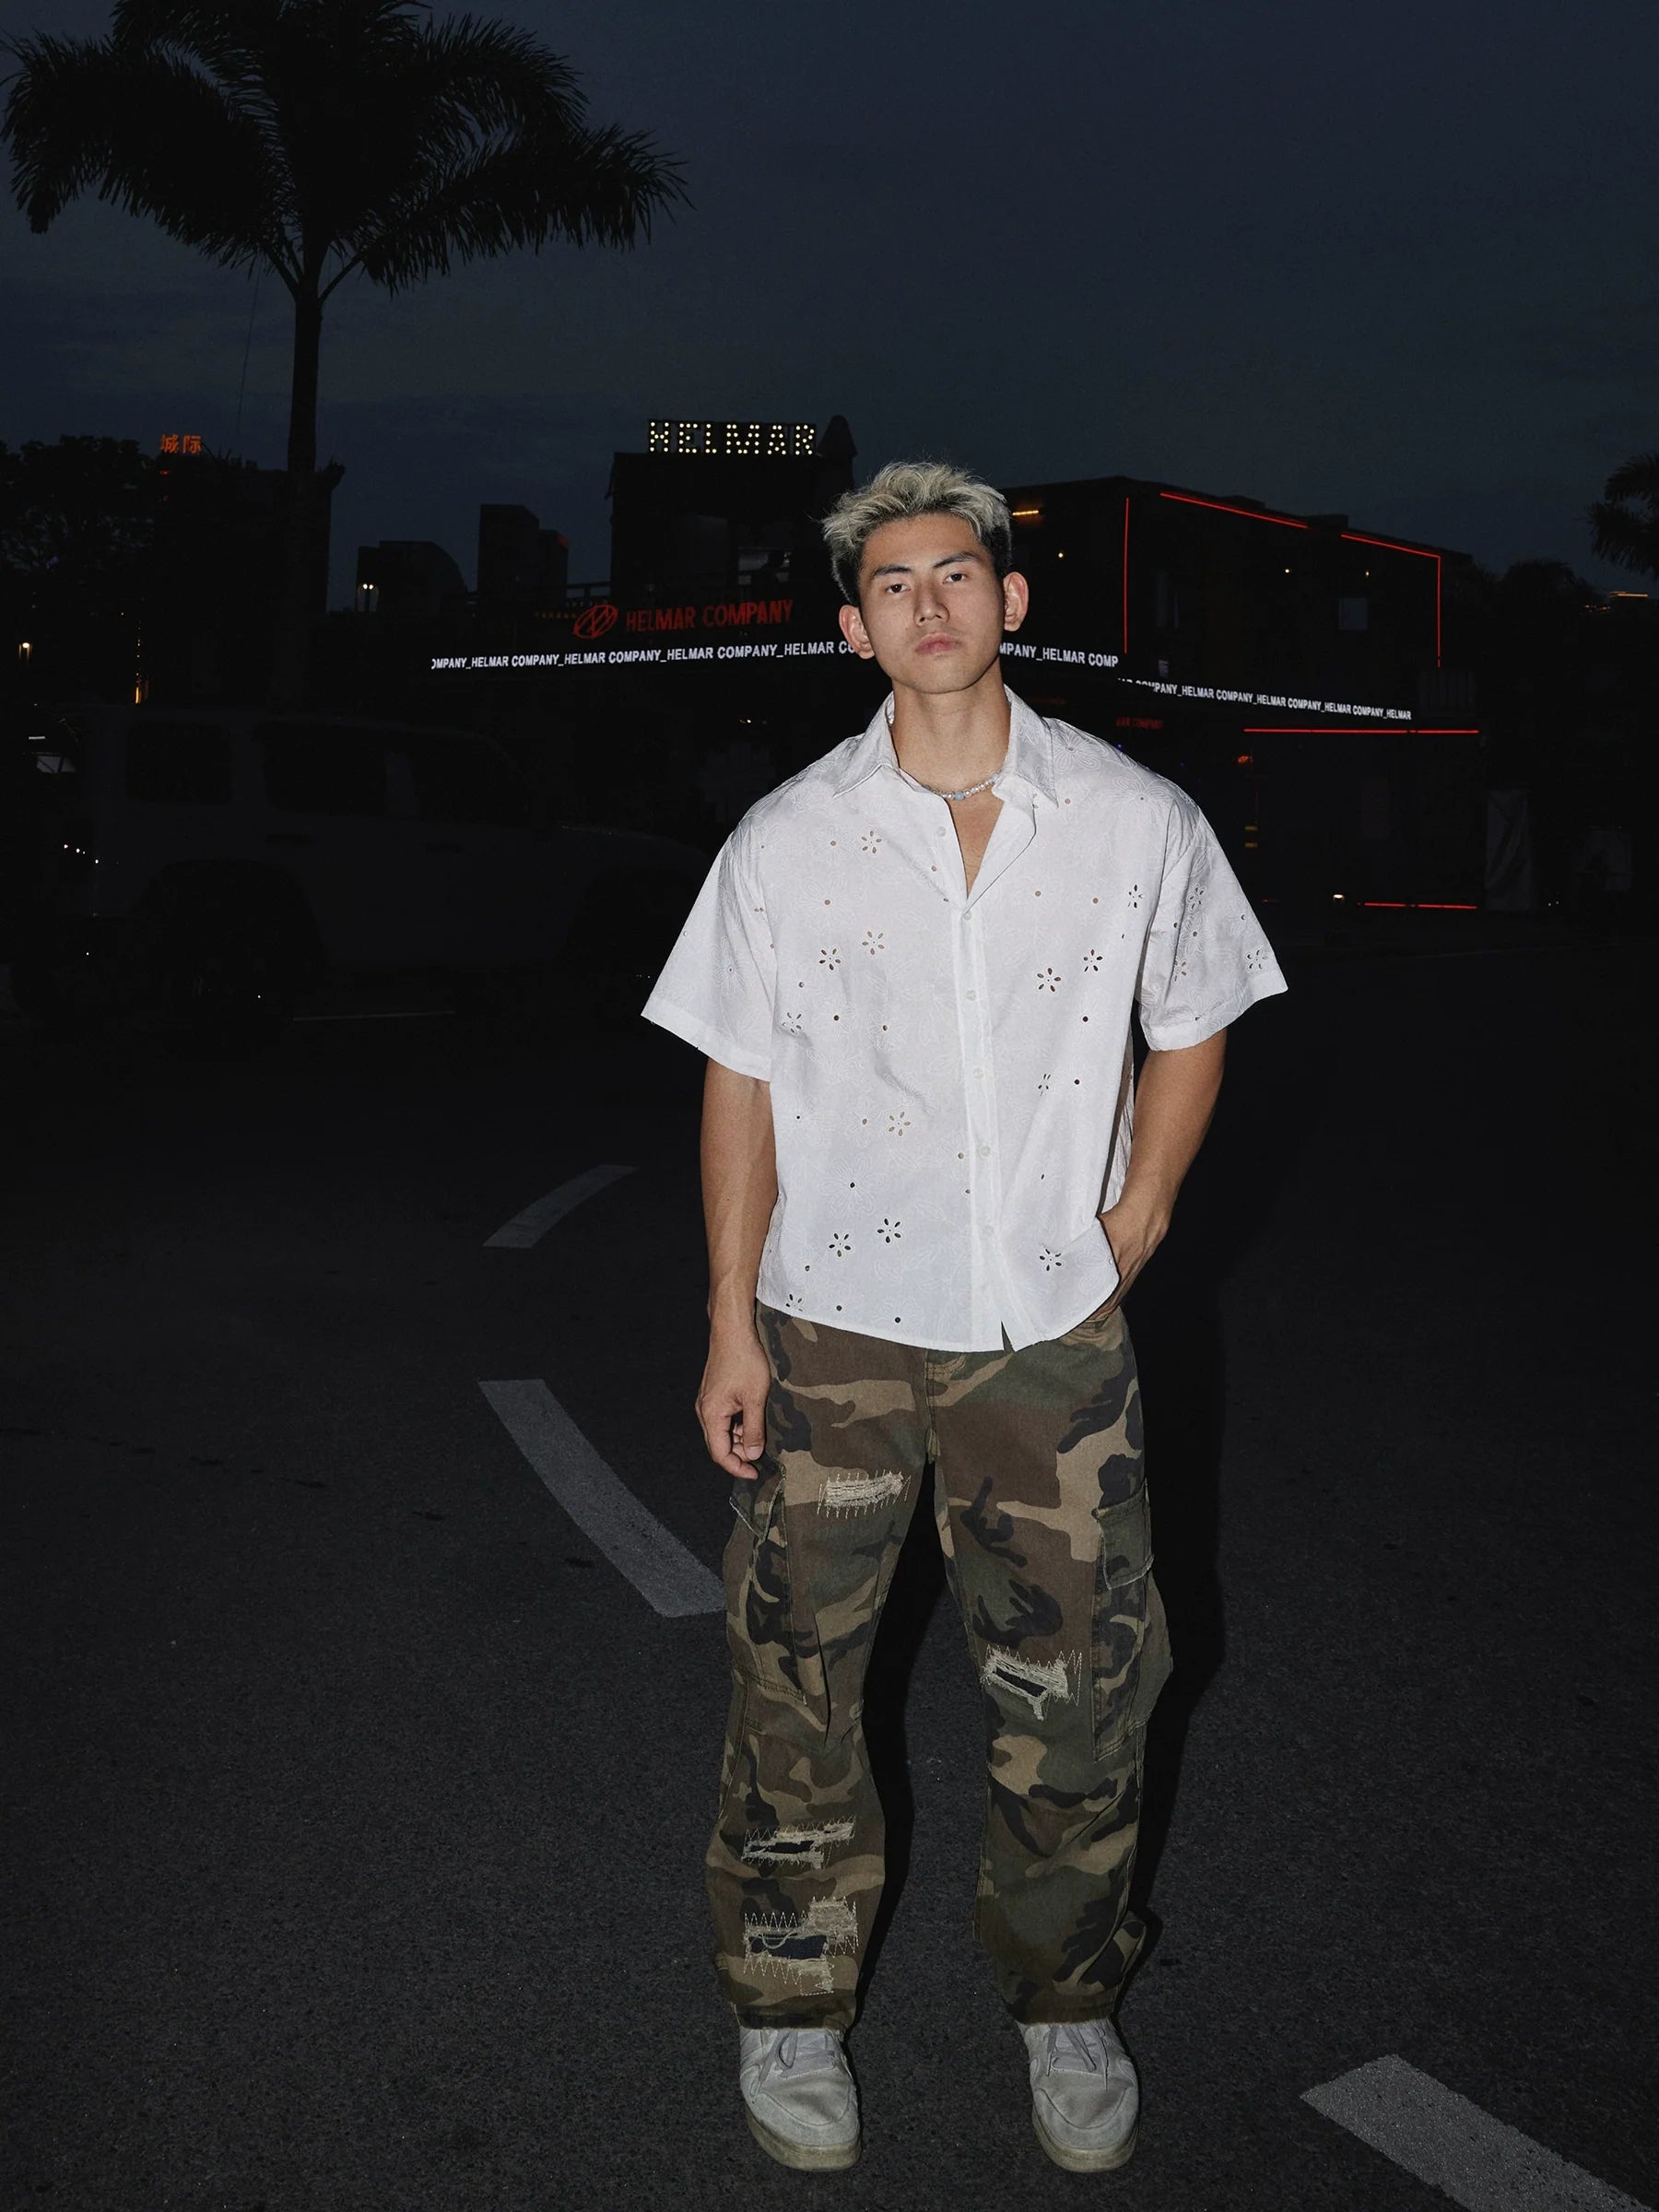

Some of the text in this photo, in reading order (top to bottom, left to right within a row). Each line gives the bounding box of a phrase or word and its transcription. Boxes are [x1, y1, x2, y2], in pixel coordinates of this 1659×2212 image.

[160, 434, 203, 454] 城际
[649, 420, 817, 455] HELMAR
[626, 599, 794, 633] HELMAR COMPANY
